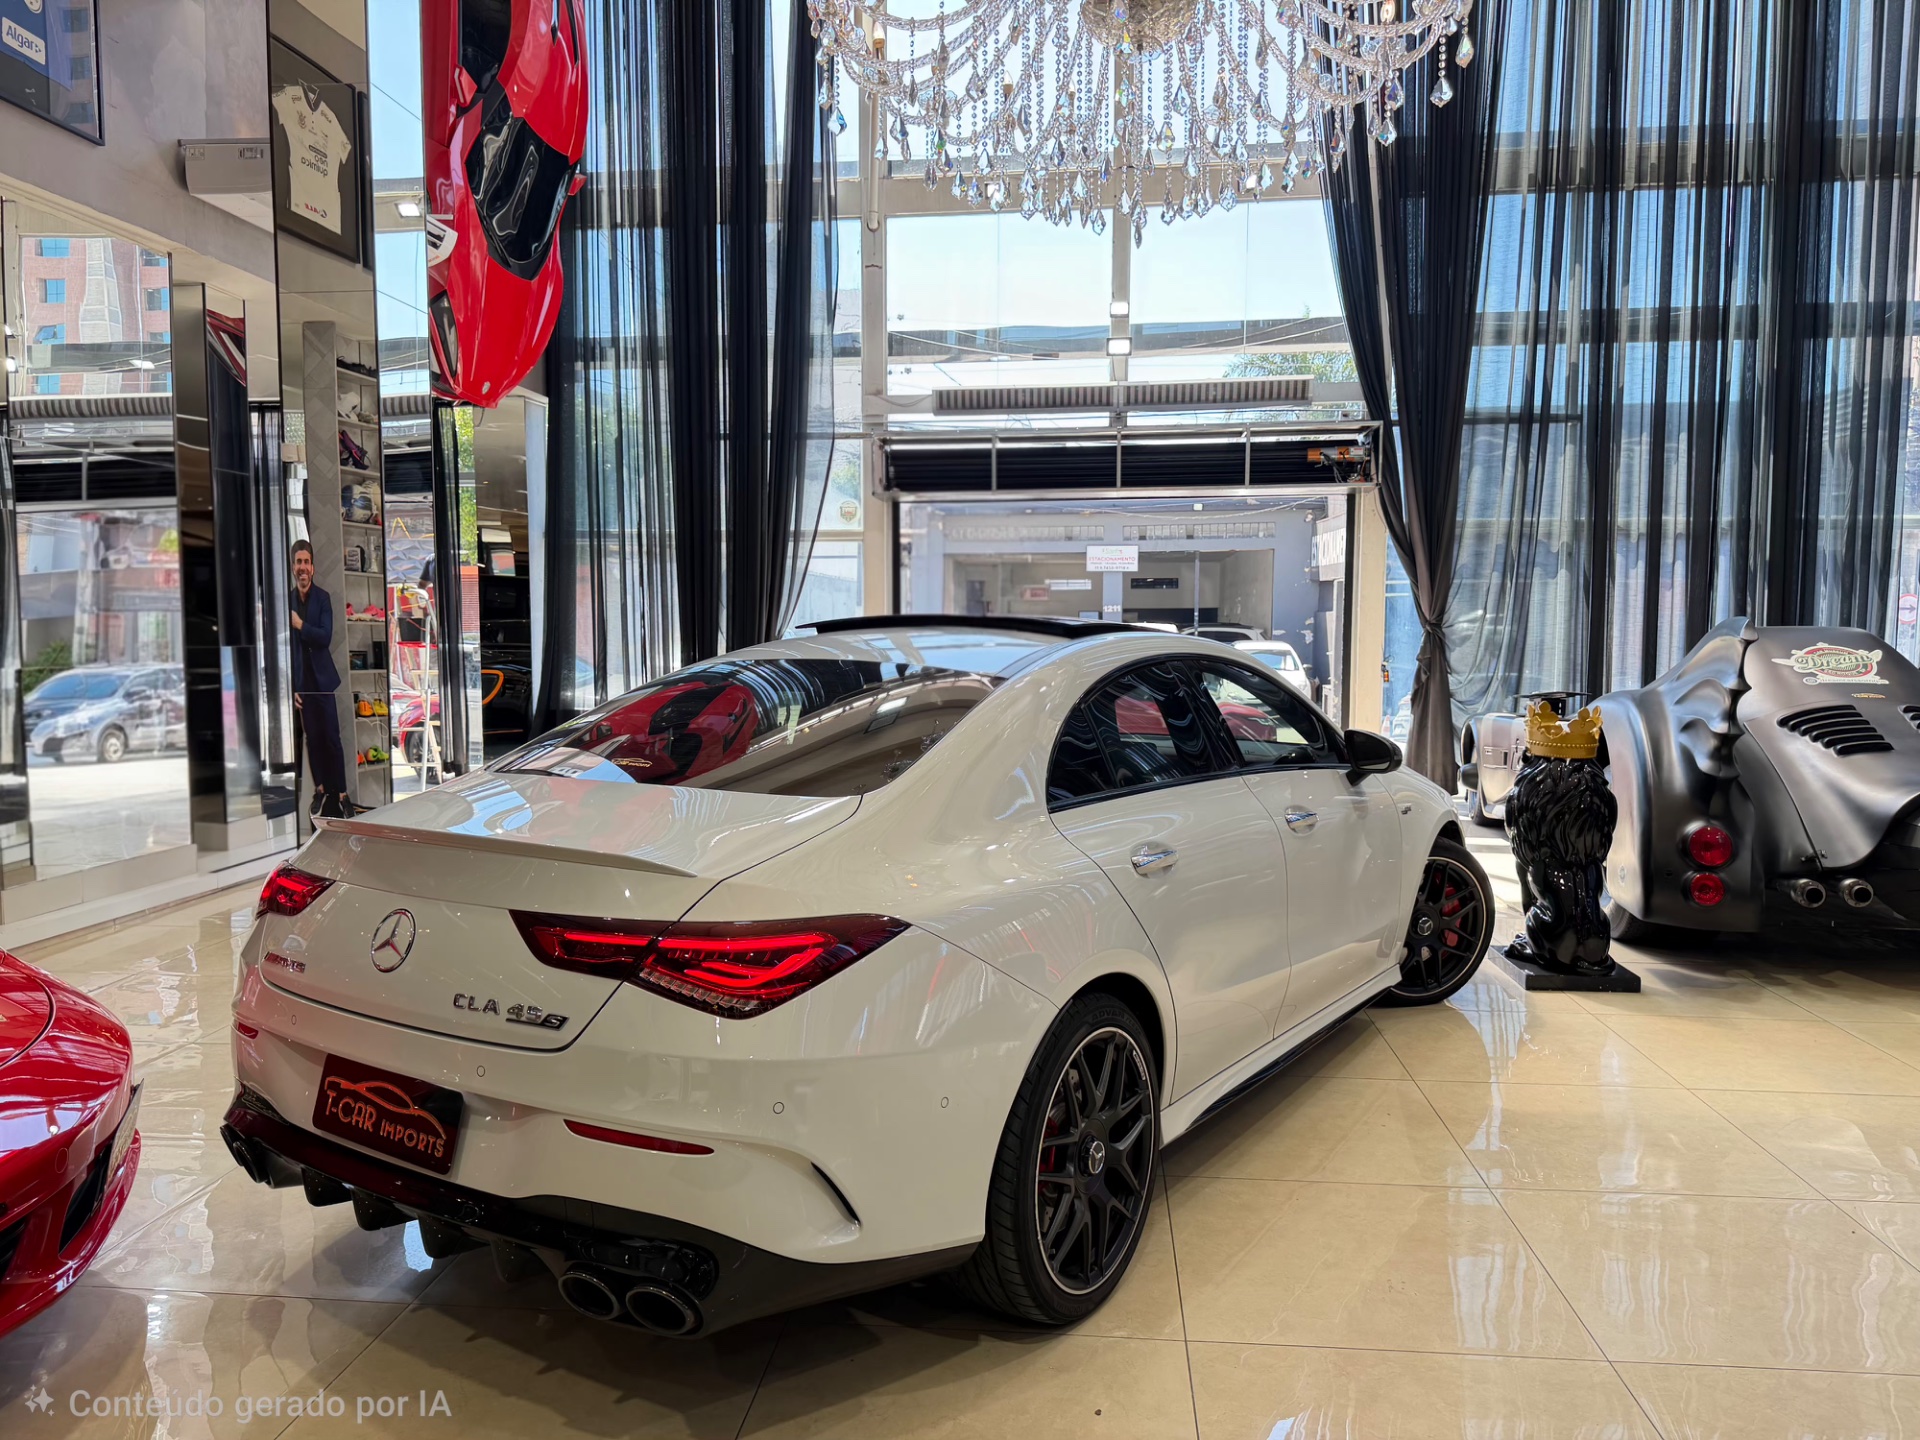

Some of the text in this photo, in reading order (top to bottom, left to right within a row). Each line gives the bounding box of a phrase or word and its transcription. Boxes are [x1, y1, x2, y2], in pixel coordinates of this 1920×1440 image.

[6, 25, 33, 51] Algar
[1795, 654, 1874, 670] Dream
[453, 993, 500, 1016] CLA
[325, 1090, 445, 1158] T-CAR IMPORTS
